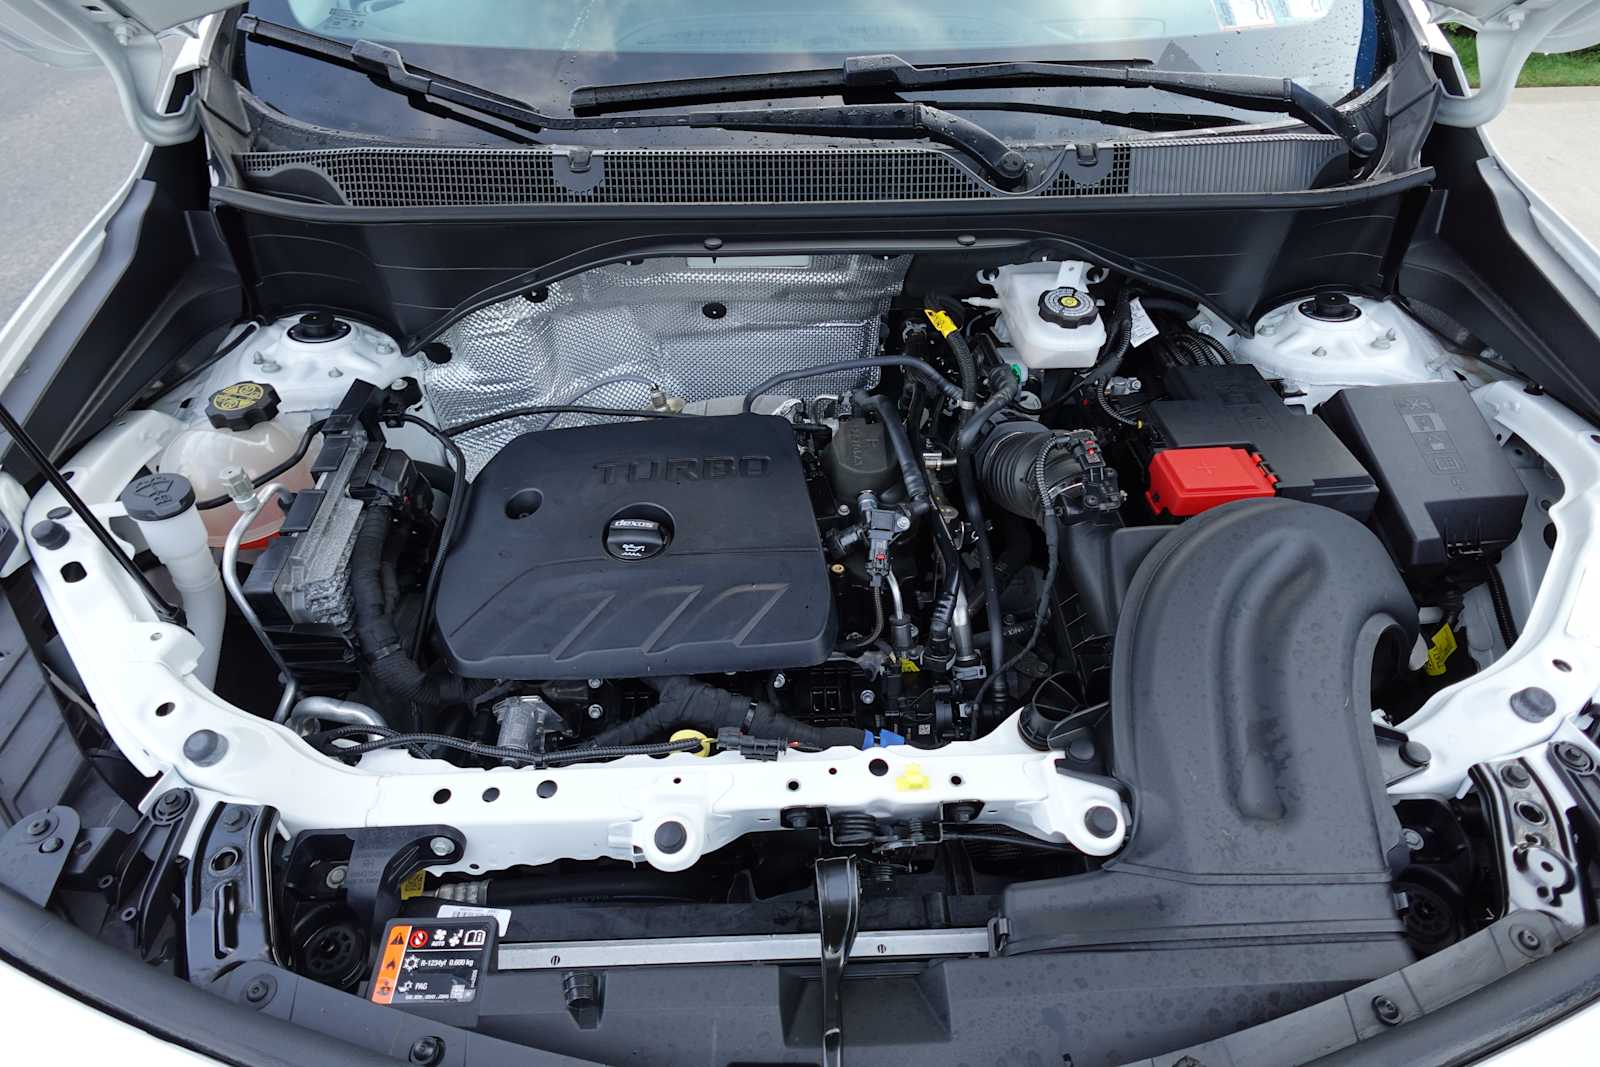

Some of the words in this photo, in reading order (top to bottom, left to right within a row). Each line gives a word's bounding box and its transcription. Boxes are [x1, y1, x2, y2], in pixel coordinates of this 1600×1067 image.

[592, 455, 771, 484] TURBO
[614, 519, 653, 528] dexos
[420, 960, 447, 968] R-1234yf
[415, 982, 428, 990] PAG
